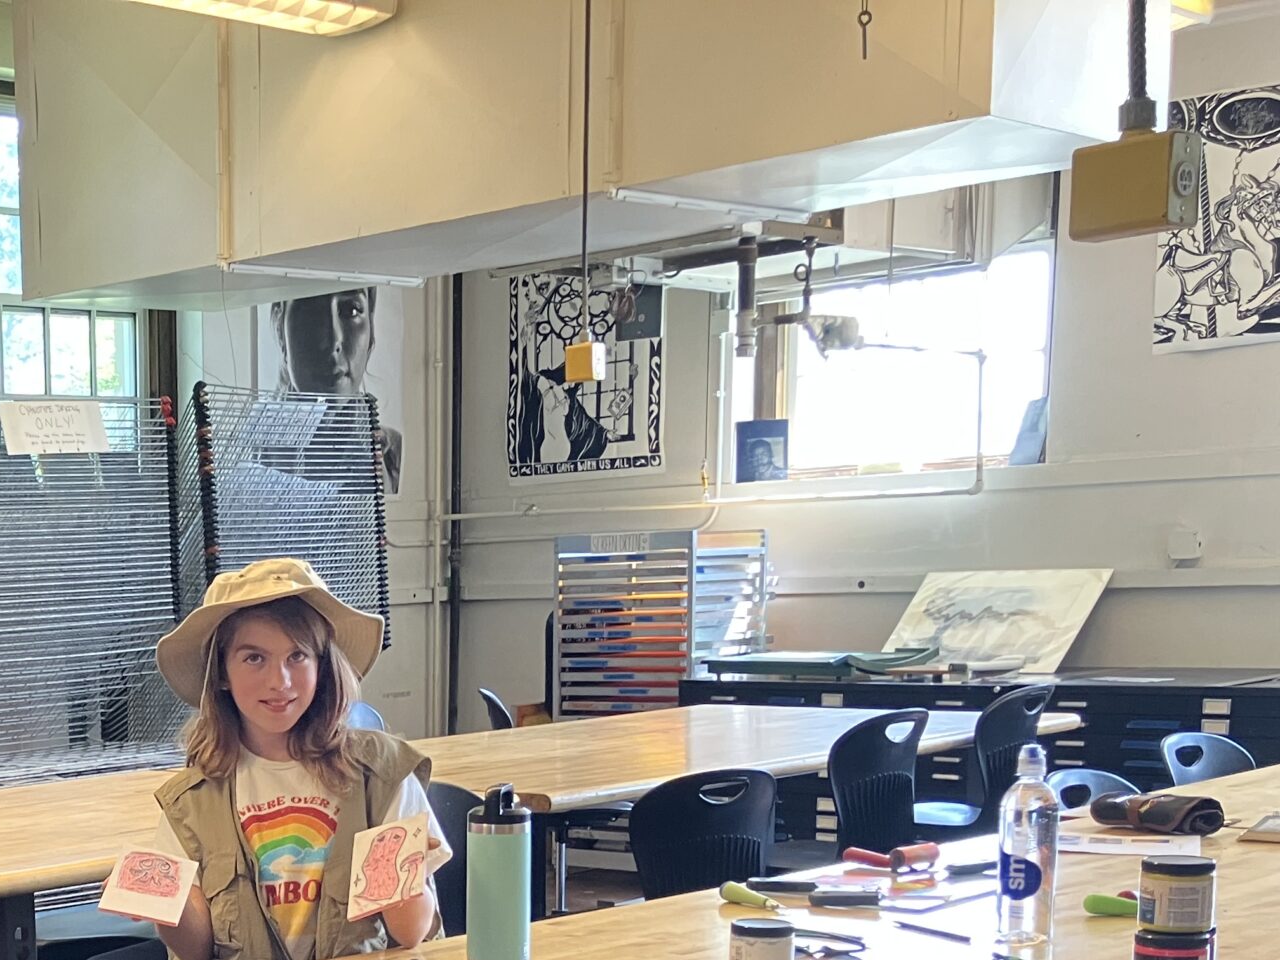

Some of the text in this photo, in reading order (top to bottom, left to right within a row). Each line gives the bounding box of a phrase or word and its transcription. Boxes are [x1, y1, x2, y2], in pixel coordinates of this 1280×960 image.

[535, 464, 554, 475] THEY
[577, 460, 597, 471] BURN
[600, 459, 611, 470] US
[613, 458, 629, 468] ALL
[290, 796, 330, 808] OVER
